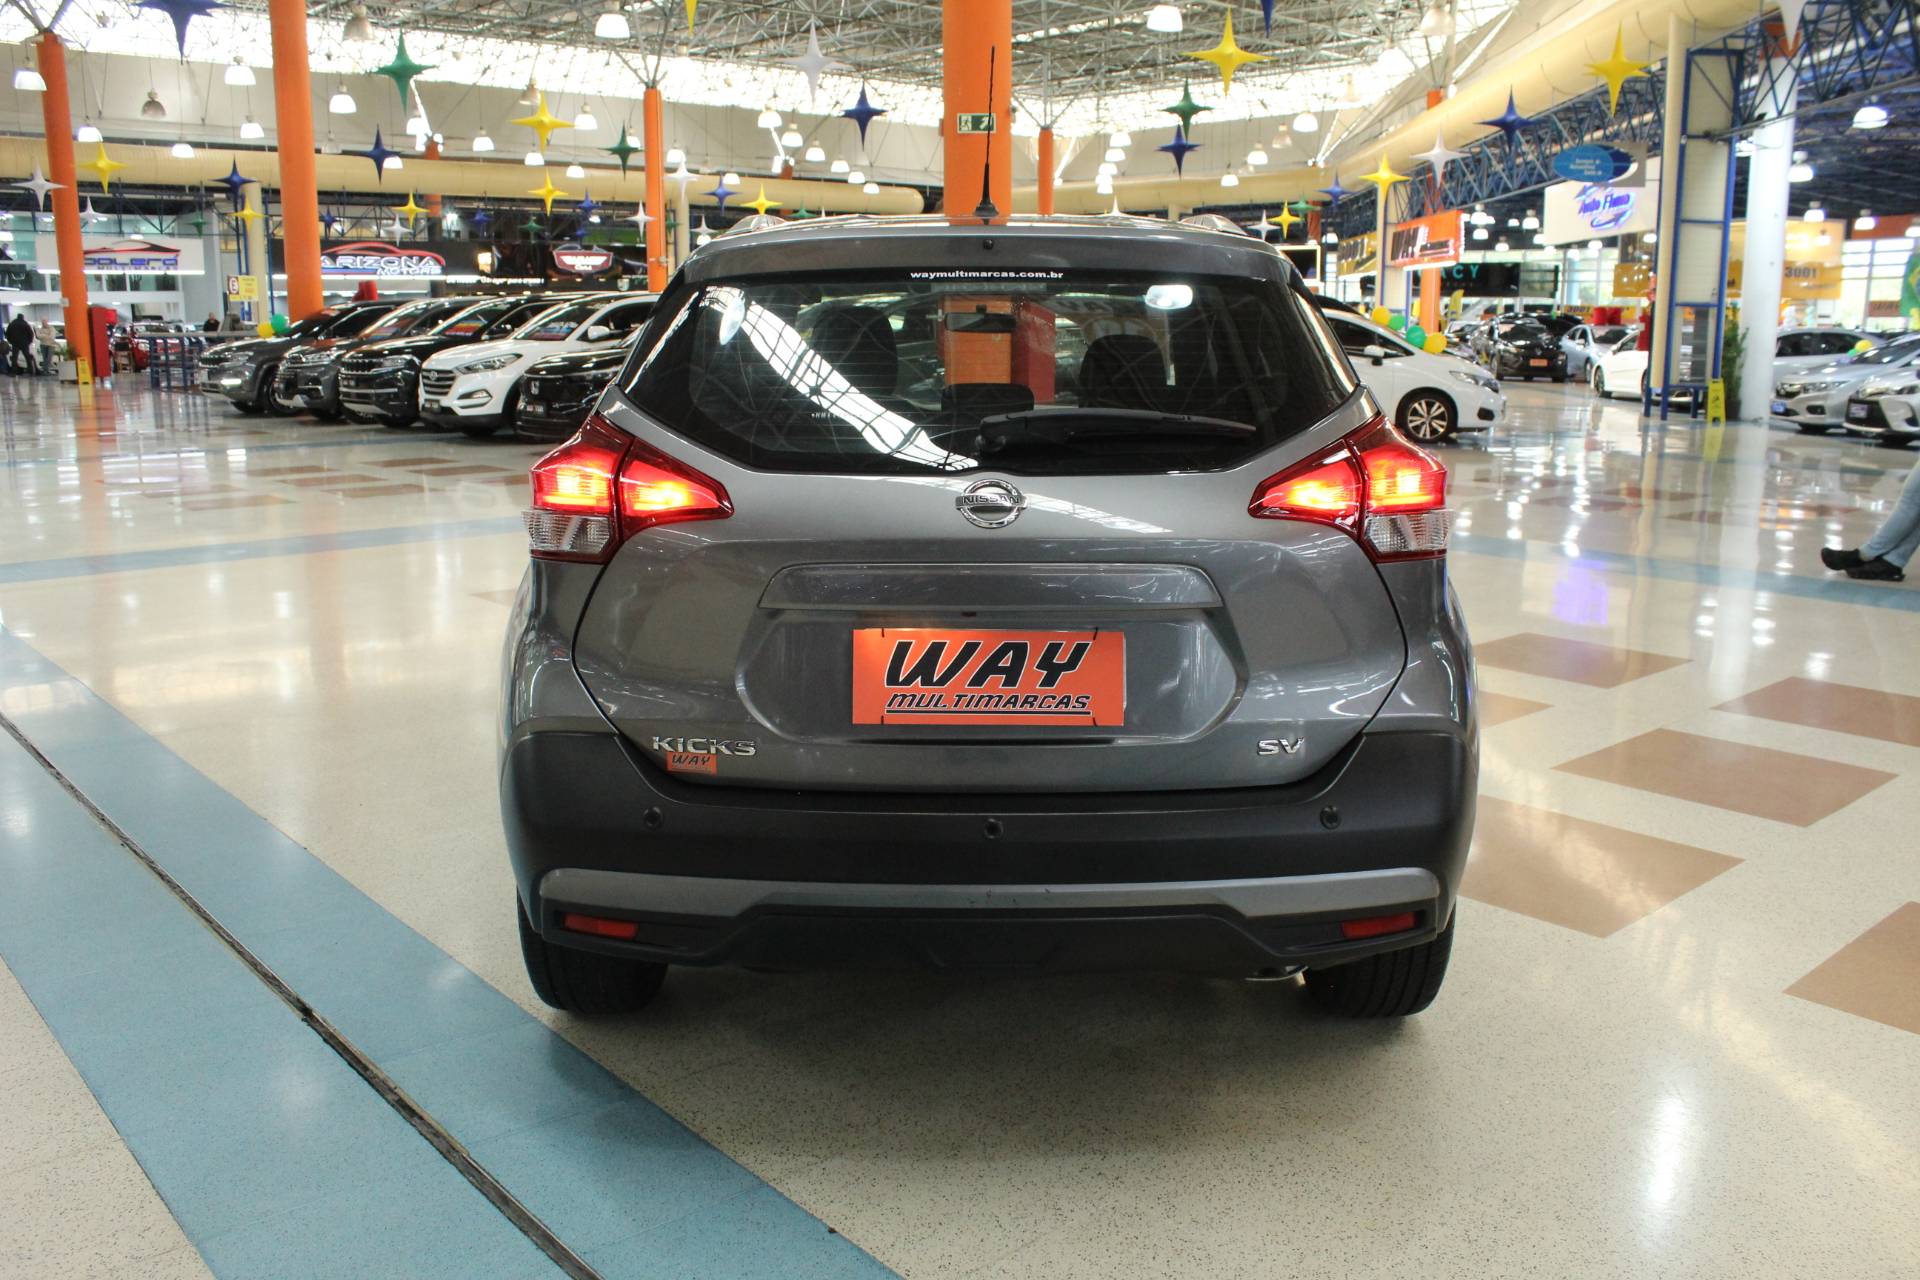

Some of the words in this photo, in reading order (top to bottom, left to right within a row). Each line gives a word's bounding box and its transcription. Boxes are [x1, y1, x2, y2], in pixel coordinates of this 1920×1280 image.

[321, 256, 440, 270] ARIZONA
[376, 267, 442, 276] MOTORS
[911, 270, 1064, 279] waymultimarcas.com.br
[1785, 266, 1817, 279] 3001
[963, 496, 1019, 504] NISSAN
[884, 640, 1093, 689] WAY
[886, 693, 1091, 709] MULTIMARCAS
[652, 736, 757, 756] KICKS
[1257, 738, 1305, 755] SV
[671, 754, 711, 766] WAY
